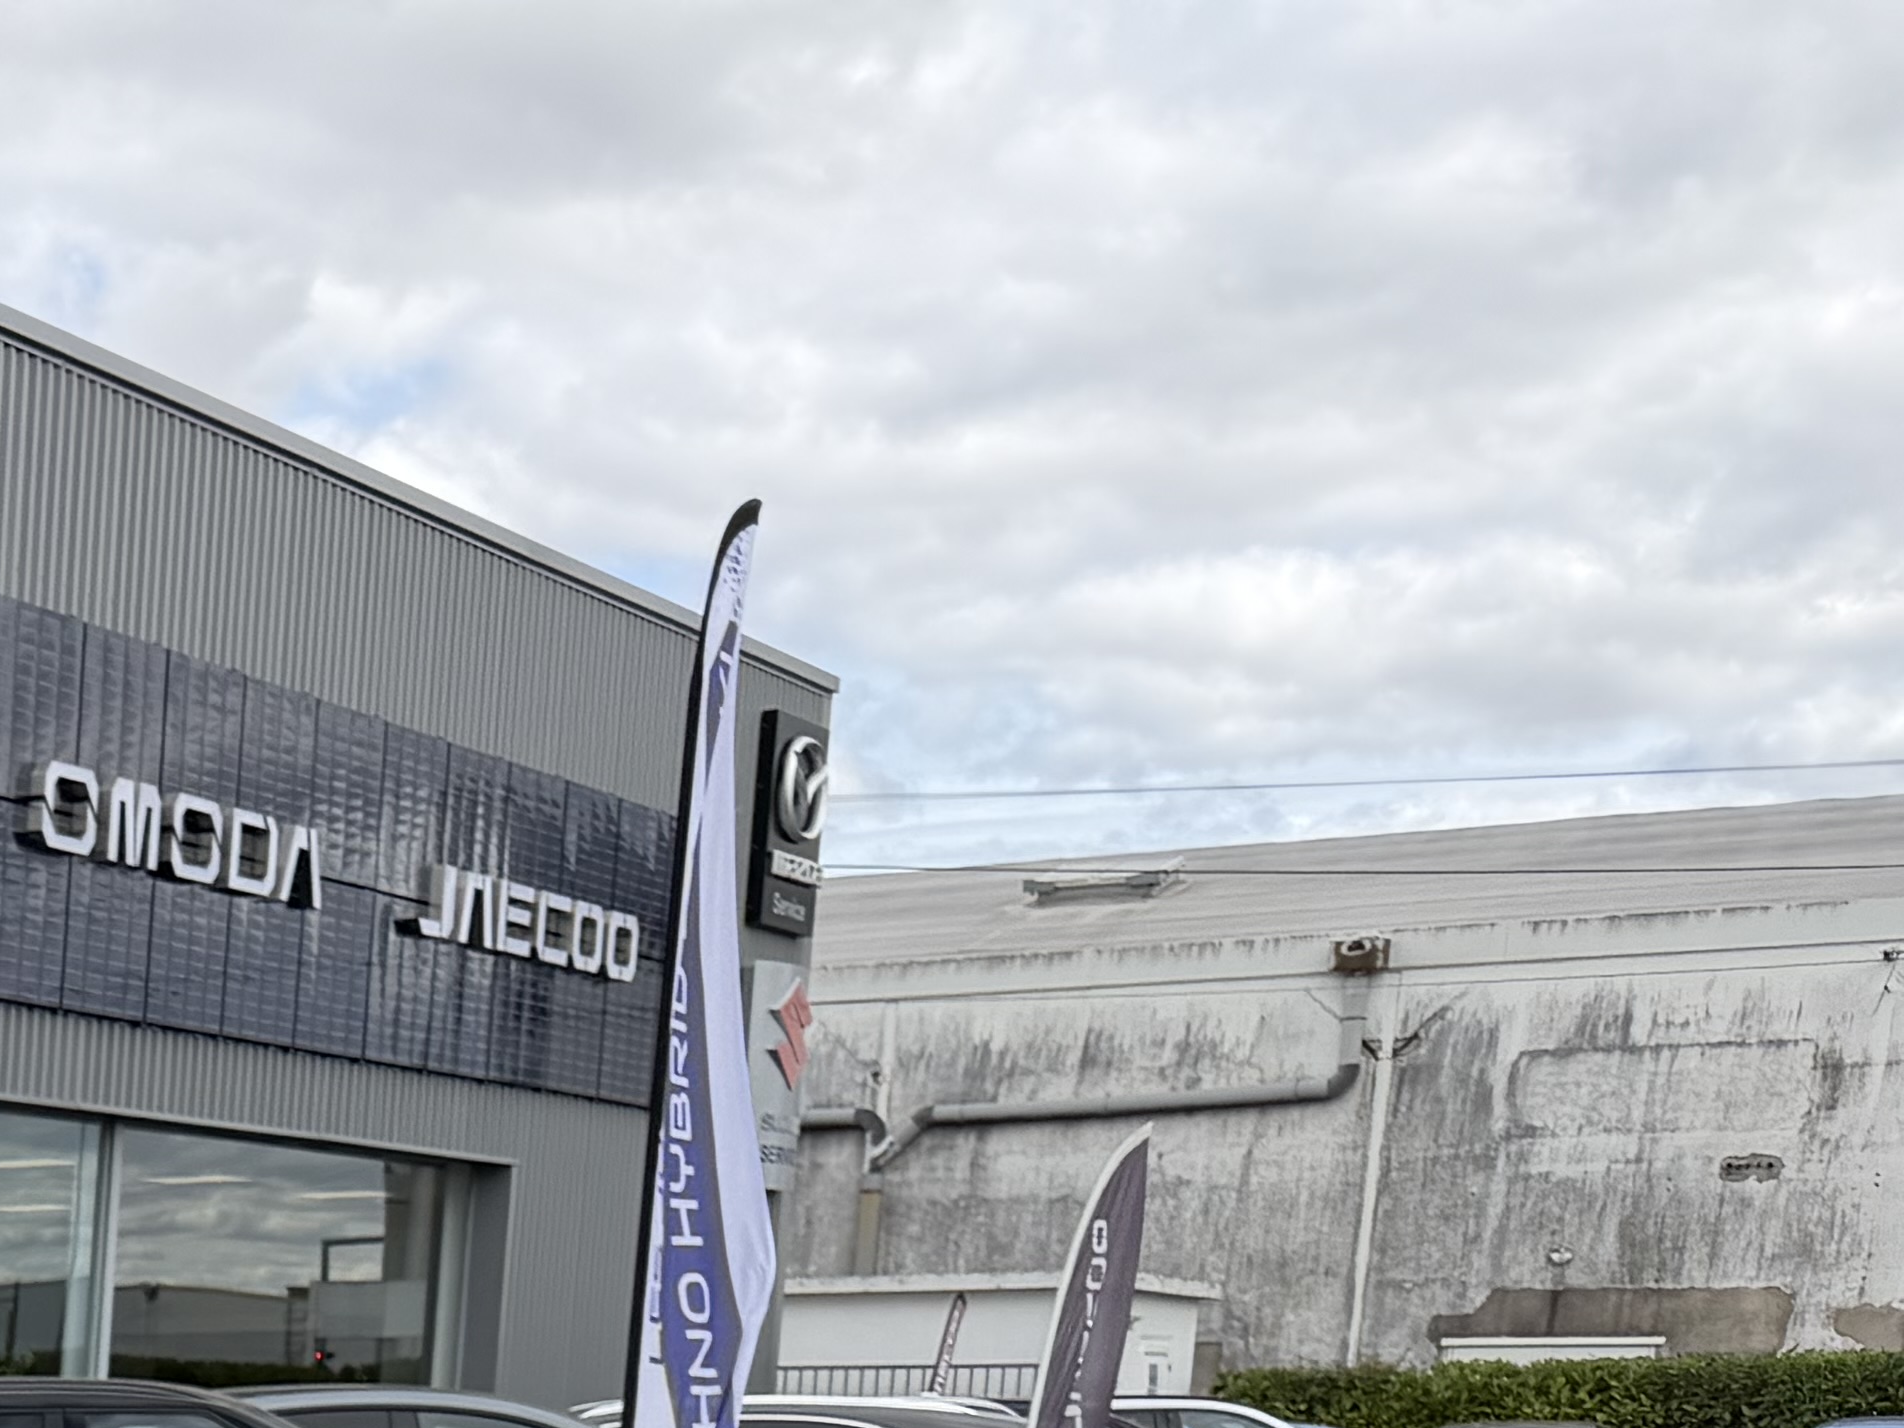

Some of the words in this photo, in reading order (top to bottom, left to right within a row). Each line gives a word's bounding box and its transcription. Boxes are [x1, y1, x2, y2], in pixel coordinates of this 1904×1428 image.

[40, 760, 322, 910] OMODA
[417, 865, 641, 983] JAECOO
[669, 966, 704, 1247] HYBRID
